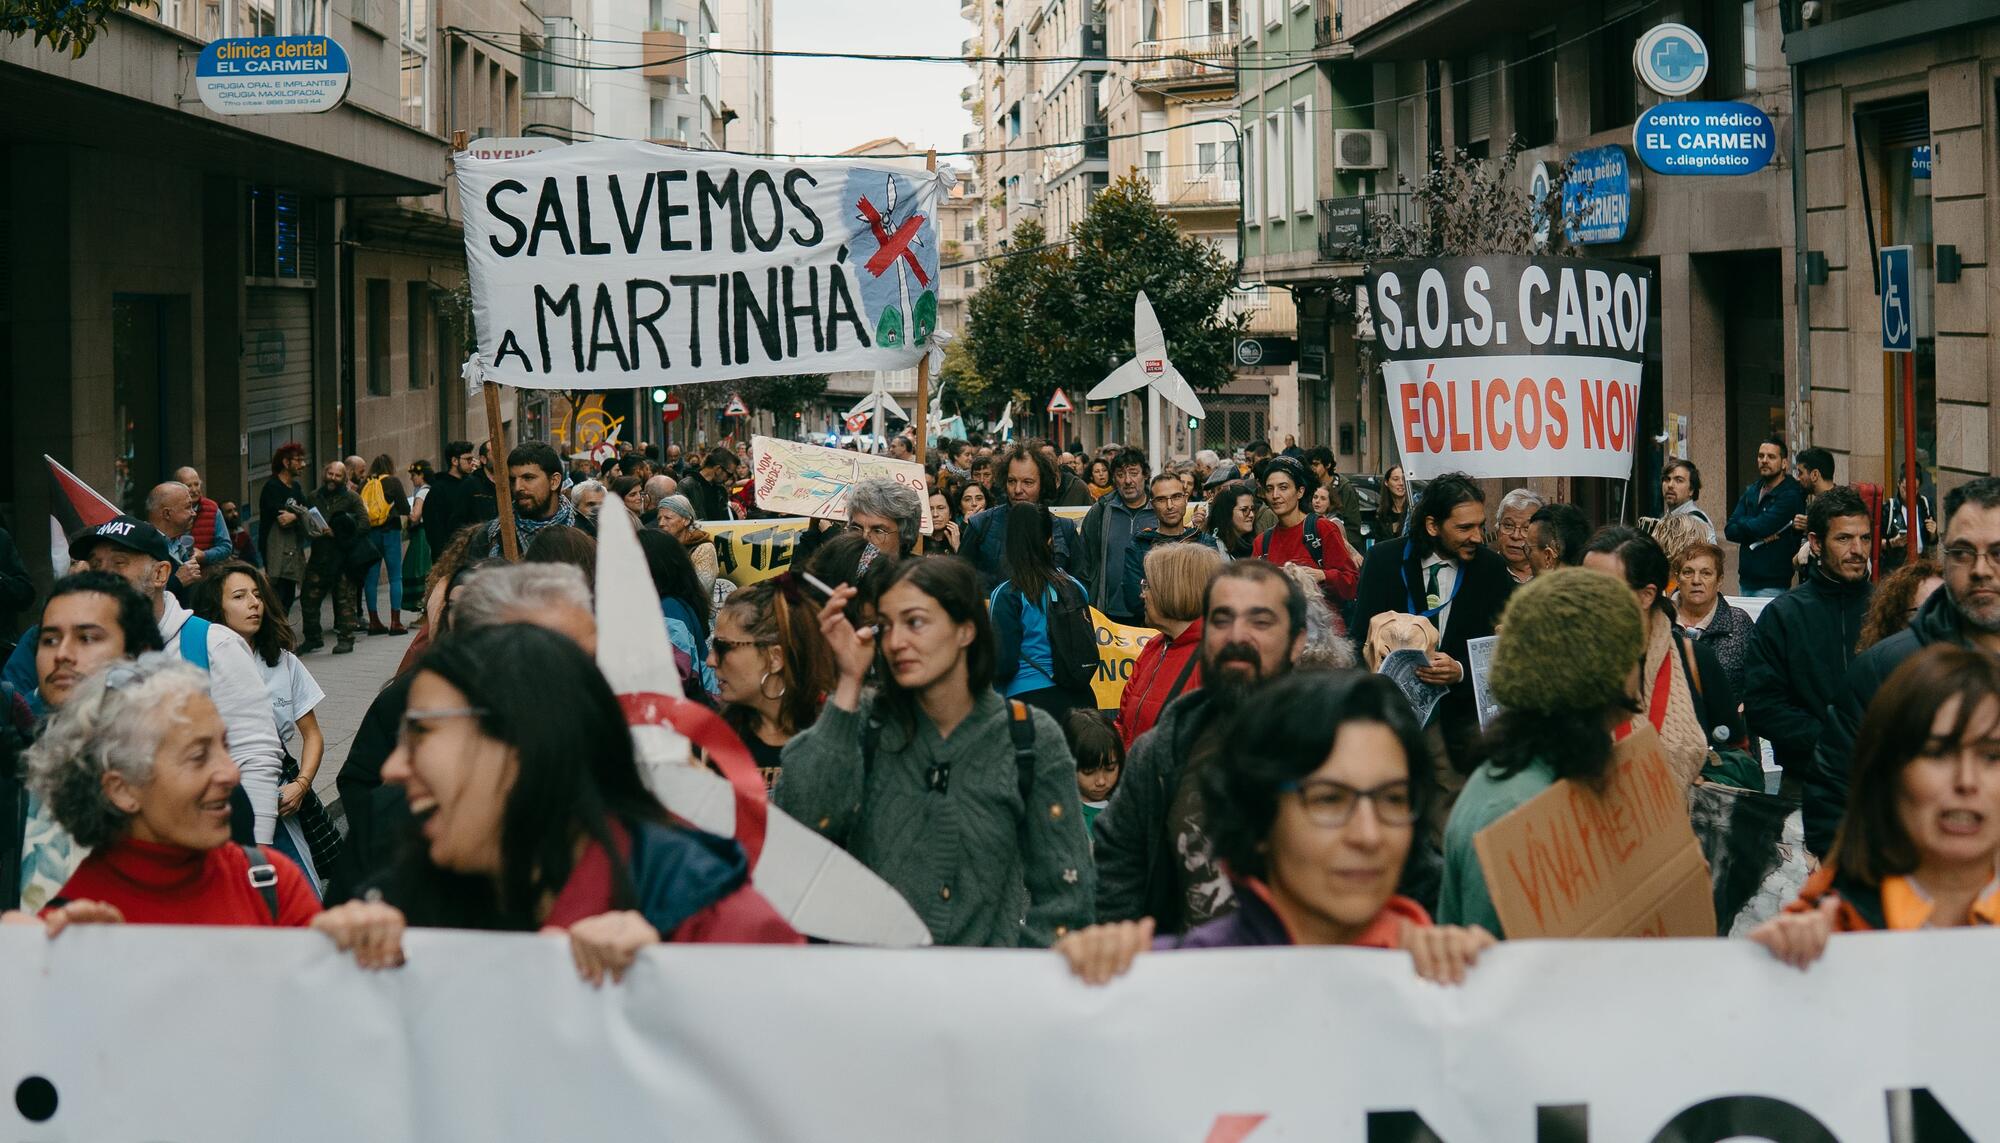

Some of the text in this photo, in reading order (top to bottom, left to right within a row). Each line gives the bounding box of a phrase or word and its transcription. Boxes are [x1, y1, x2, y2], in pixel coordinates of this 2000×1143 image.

[217, 39, 328, 60] clínica dental
[216, 59, 328, 73] EL CARMEN
[247, 81, 273, 89] ORAL
[283, 79, 337, 88] IMPLANTES
[258, 89, 326, 98] MAXILOFACIAL
[1650, 112, 1762, 127] centro médico
[1646, 133, 1767, 150] EL CARMEN
[1665, 154, 1750, 168] c.diagnóstico
[486, 168, 824, 258] SALVEMOS
[494, 243, 872, 374] A MARTINHÁ
[1377, 265, 1507, 351] S.O.S.
[1400, 363, 1638, 455] EÓLICOS NON
[756, 452, 773, 476] NON
[757, 462, 783, 500] ROUBEDES
